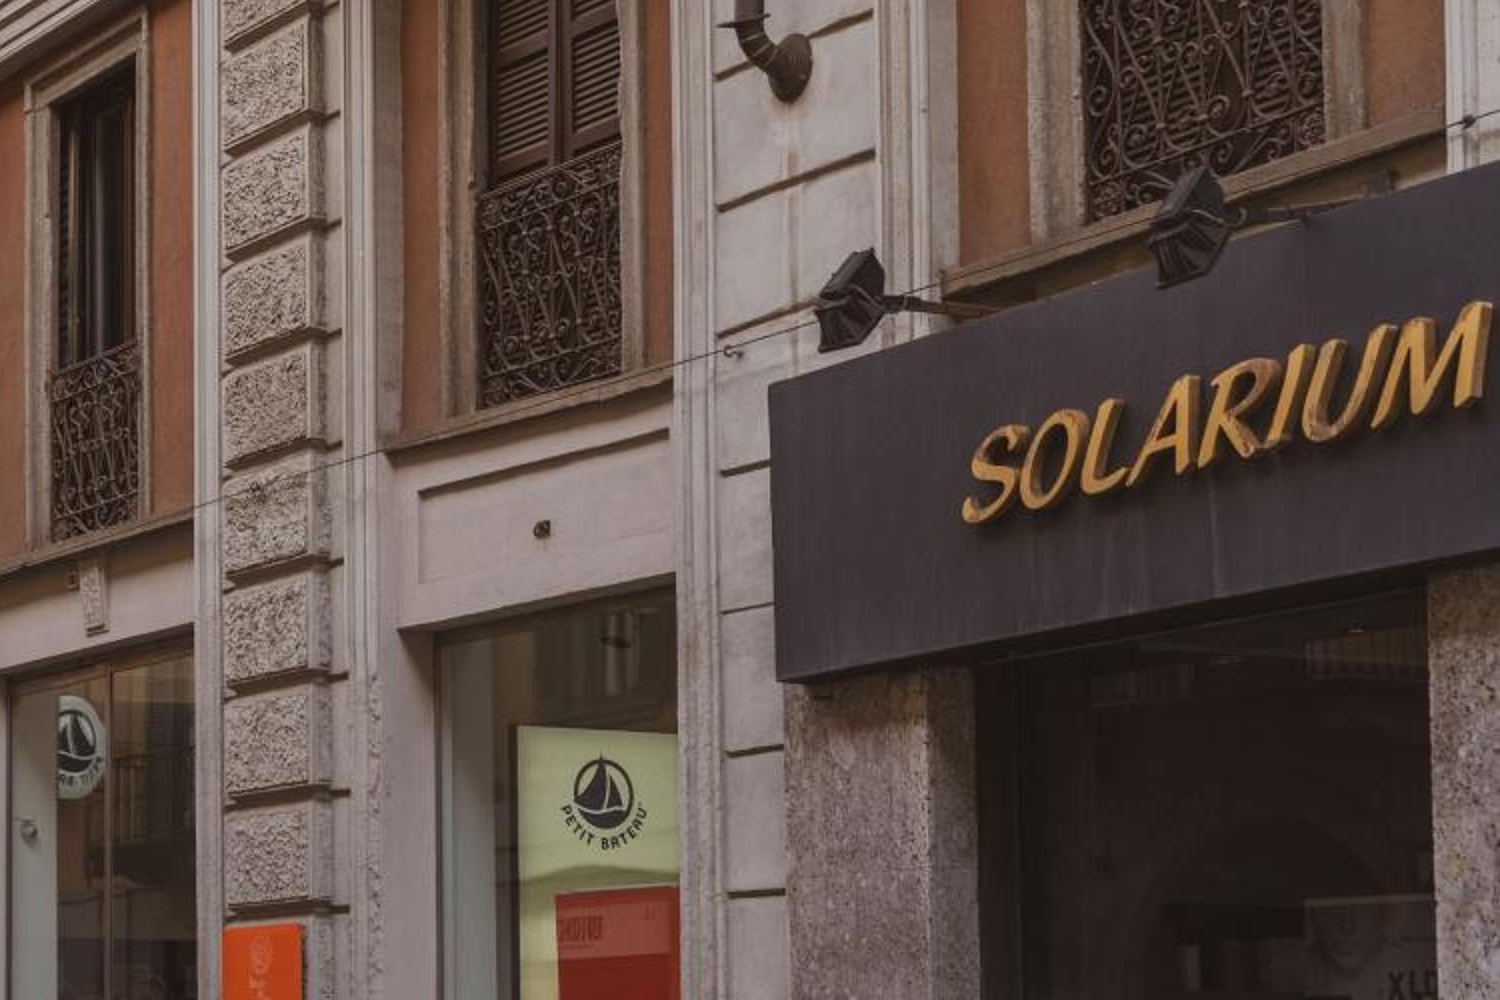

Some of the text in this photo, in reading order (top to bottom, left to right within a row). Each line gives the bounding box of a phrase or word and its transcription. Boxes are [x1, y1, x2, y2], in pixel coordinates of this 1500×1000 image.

[961, 299, 1493, 524] SOLARIUM
[560, 804, 648, 851] PETIT BATEAU
